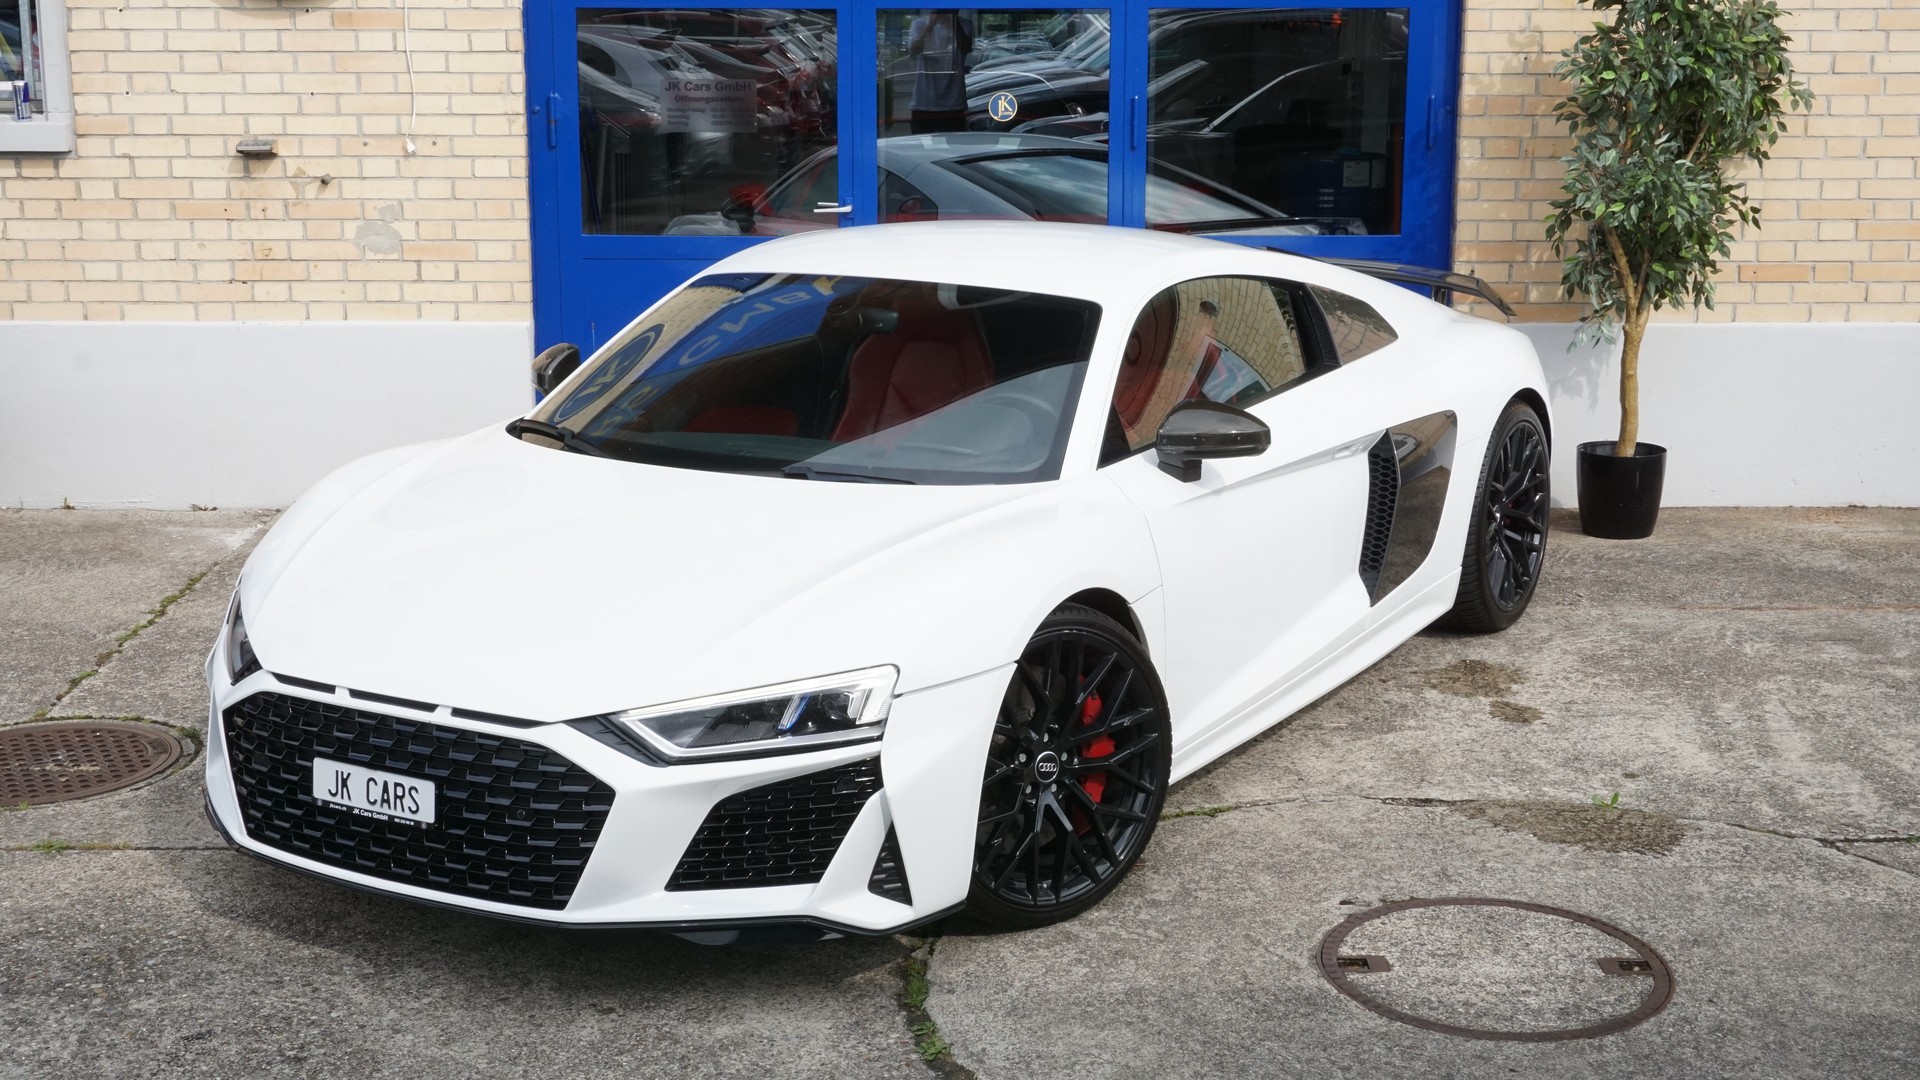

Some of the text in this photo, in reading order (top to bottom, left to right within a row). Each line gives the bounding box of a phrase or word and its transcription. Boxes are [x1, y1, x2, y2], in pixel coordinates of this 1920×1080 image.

[665, 81, 752, 92] JK Cars GmbH
[328, 769, 421, 815] JK CARS
[360, 810, 372, 818] Cars
[373, 813, 389, 821] GmbH
